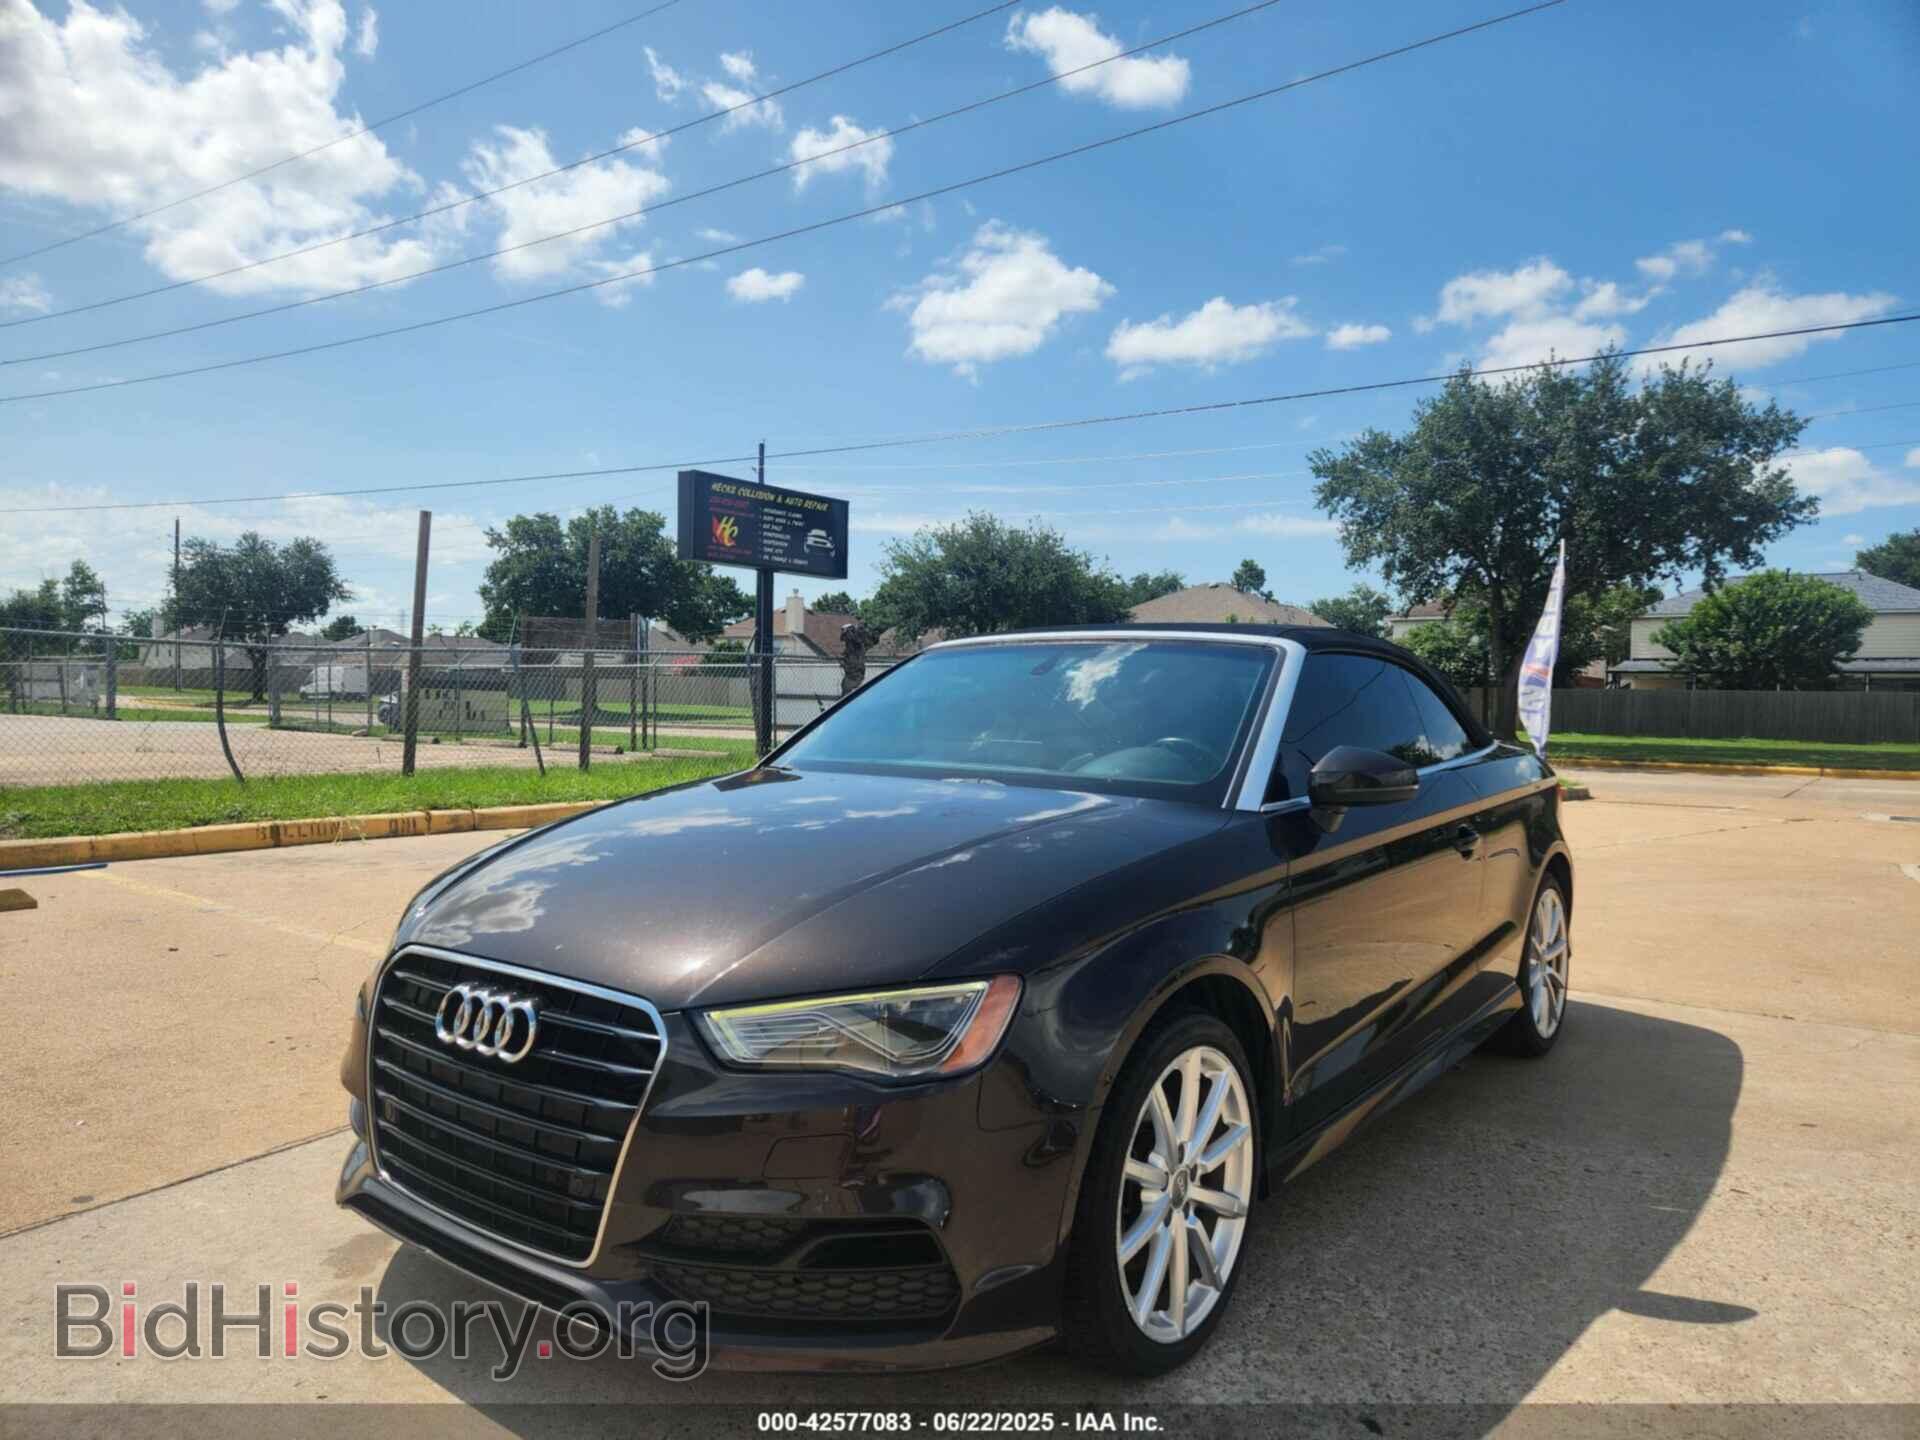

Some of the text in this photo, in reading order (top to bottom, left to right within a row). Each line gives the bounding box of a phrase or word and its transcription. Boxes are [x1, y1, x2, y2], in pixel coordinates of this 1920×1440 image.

[737, 487, 776, 502] COLLISION
[785, 497, 803, 507] AUTO
[804, 500, 829, 512] REPAIR
